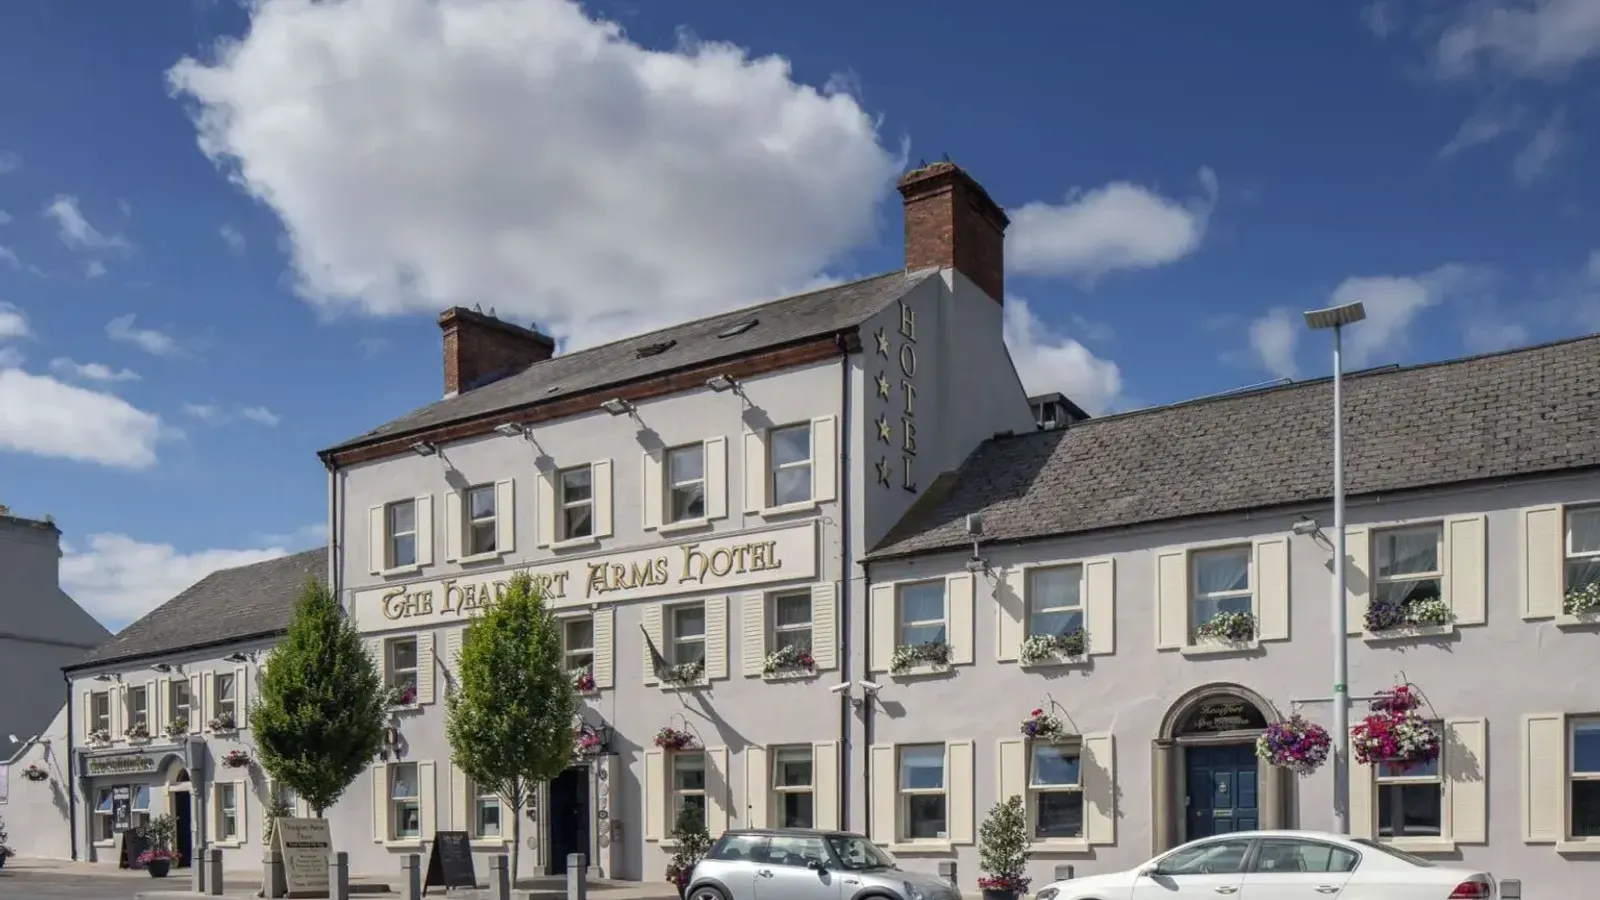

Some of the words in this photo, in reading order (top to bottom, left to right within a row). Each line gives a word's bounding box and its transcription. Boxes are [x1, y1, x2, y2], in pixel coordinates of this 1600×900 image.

[898, 300, 917, 494] HOTEL
[382, 586, 433, 620] THE
[440, 571, 569, 615] HEADRT
[585, 558, 668, 598] ARMS
[678, 540, 782, 584] HOTEL
